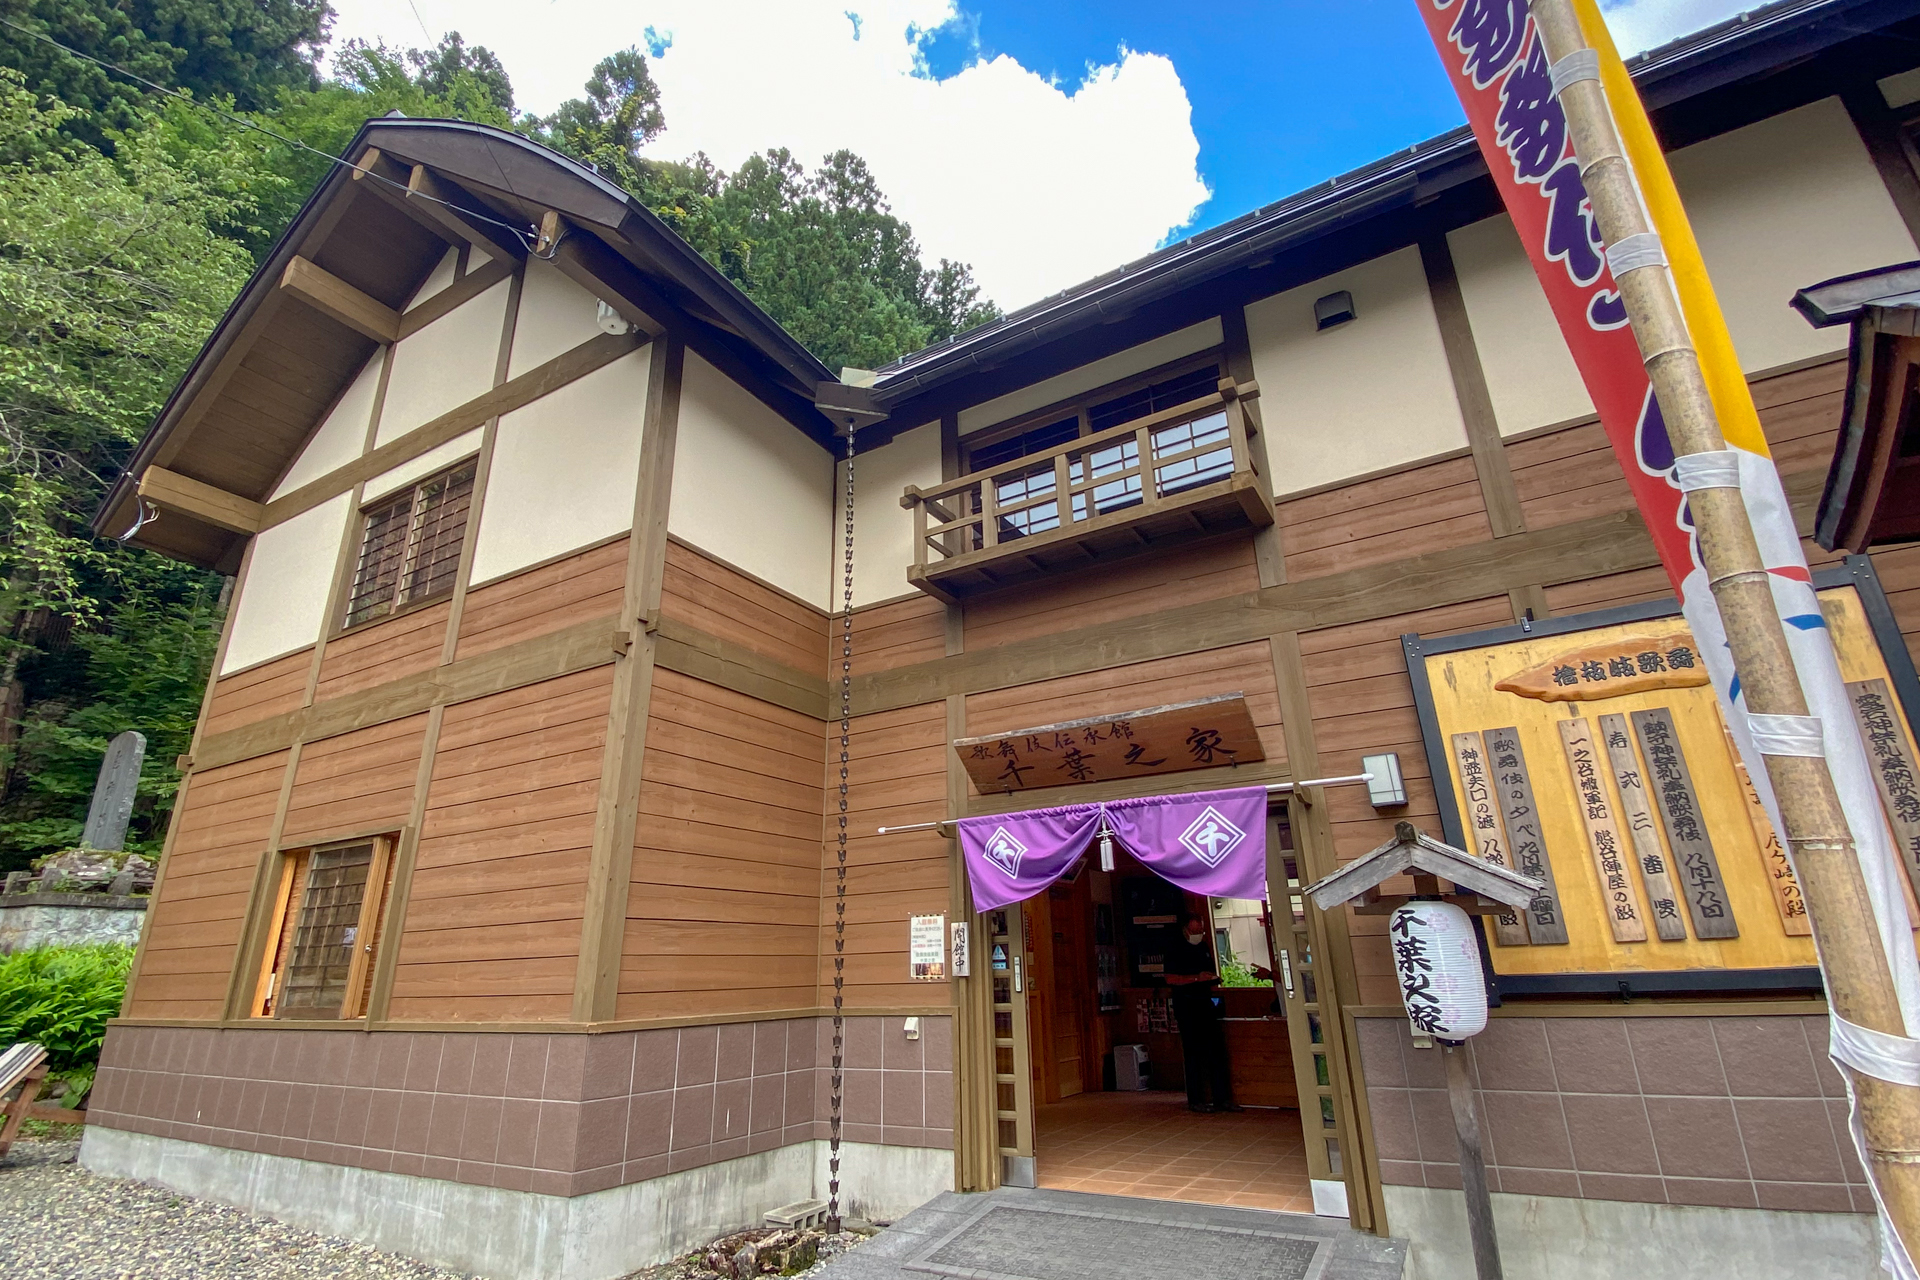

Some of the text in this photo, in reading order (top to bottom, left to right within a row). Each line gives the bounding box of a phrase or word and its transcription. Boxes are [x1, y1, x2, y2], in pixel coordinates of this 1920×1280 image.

[1552, 646, 1704, 687] 檜枝岐歌舞
[969, 721, 1134, 763] 歌舞伎伝承館
[997, 727, 1238, 787] 千葉之家
[1594, 829, 1637, 921] 熊谷陣屋の段
[952, 927, 966, 972] 開館中
[1391, 909, 1450, 1033] 千葉之家
